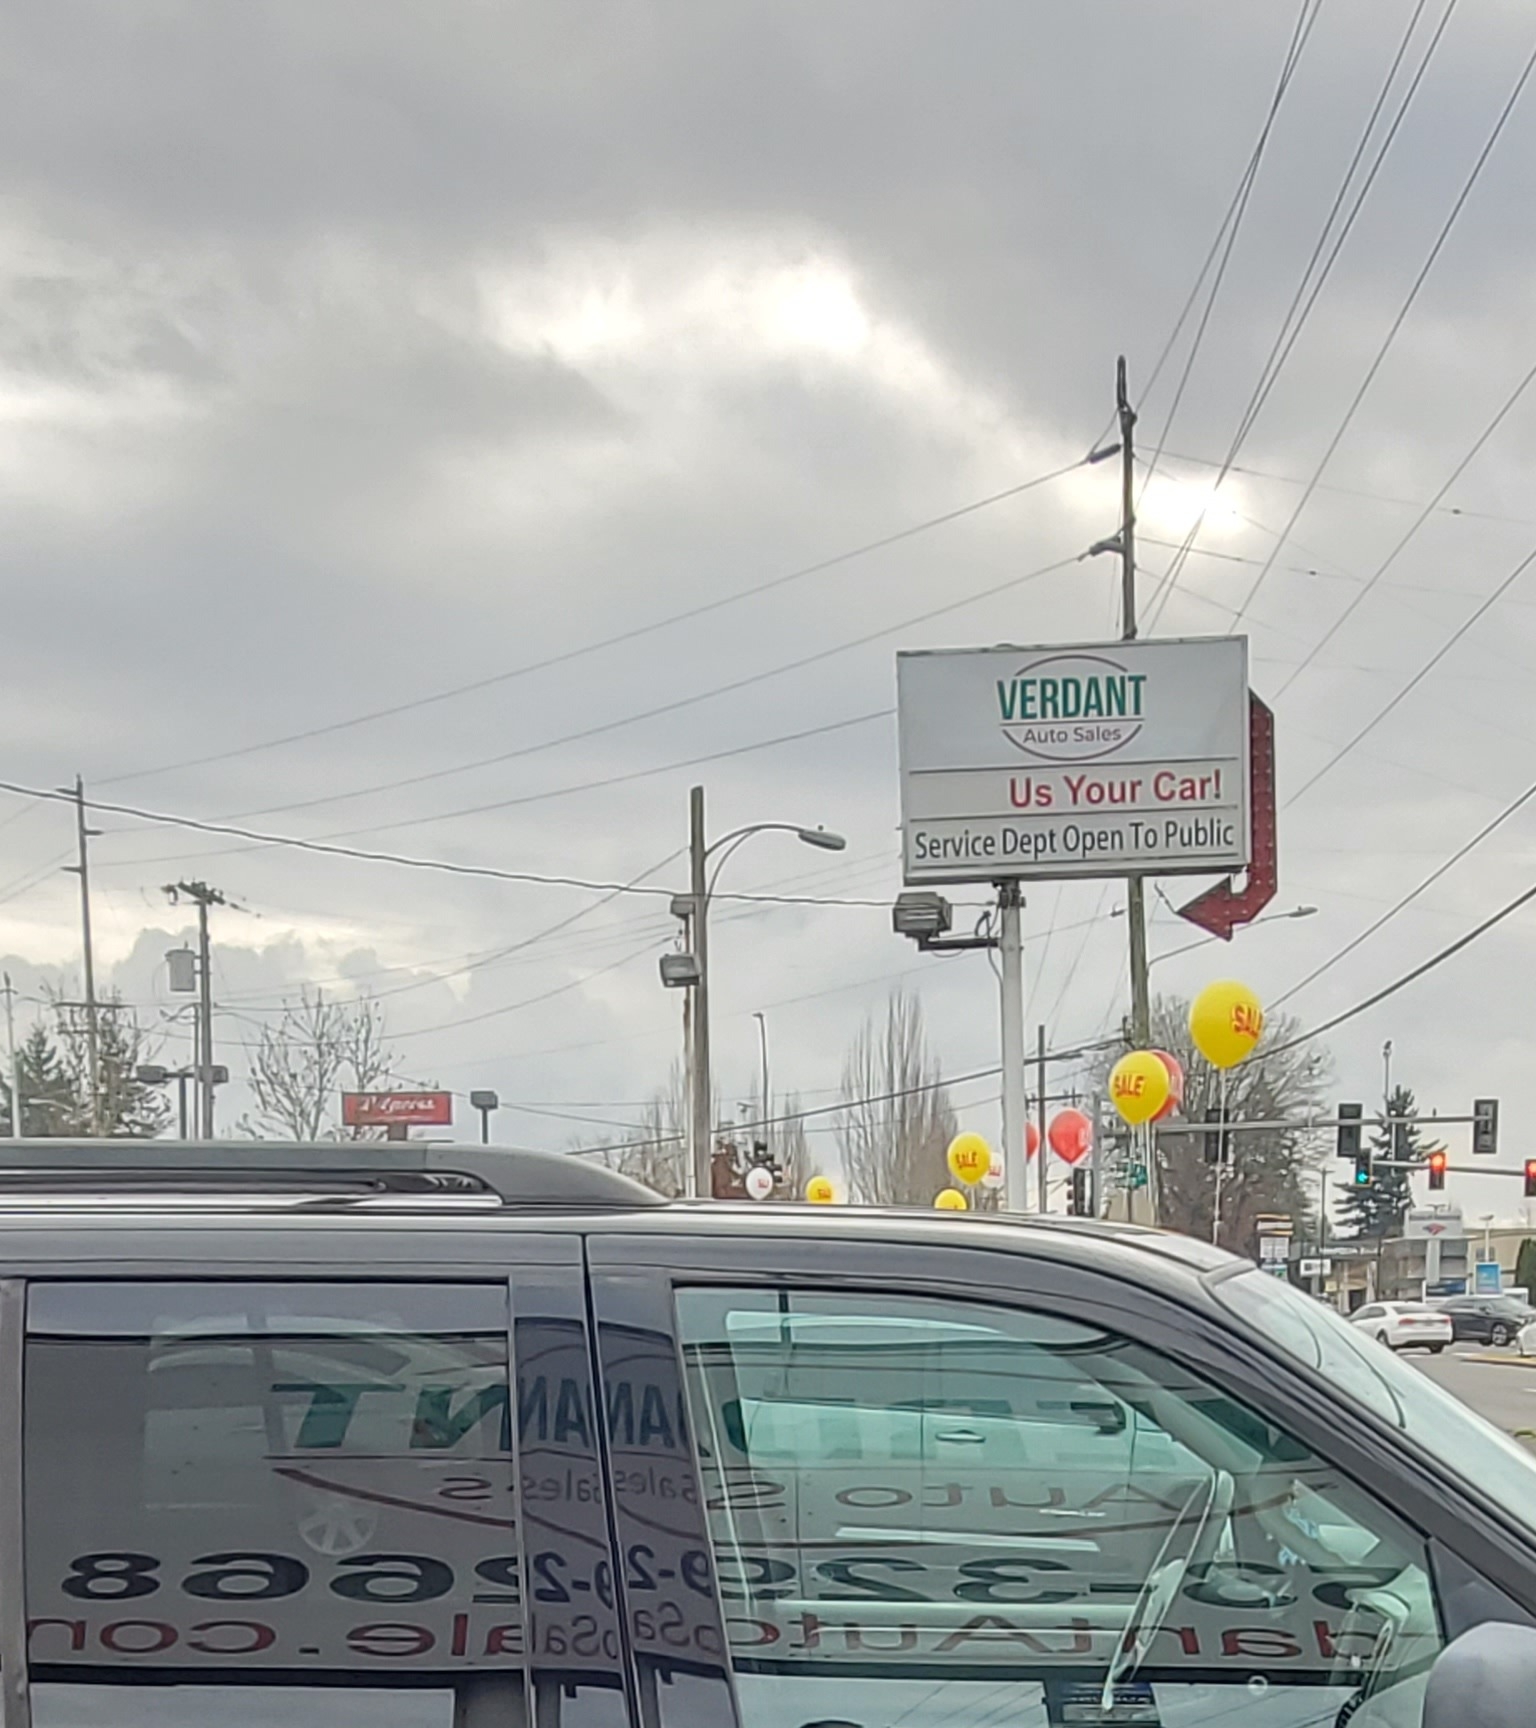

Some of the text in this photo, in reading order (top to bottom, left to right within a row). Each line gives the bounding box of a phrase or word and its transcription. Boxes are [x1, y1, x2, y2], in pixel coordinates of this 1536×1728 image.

[997, 674, 1147, 720] VERDANT
[1022, 725, 1122, 745] Auto Sales
[1009, 769, 1222, 808] Us Your Car!
[914, 817, 1235, 861] Service Dept Open To Public
[1115, 1073, 1146, 1099] SALE
